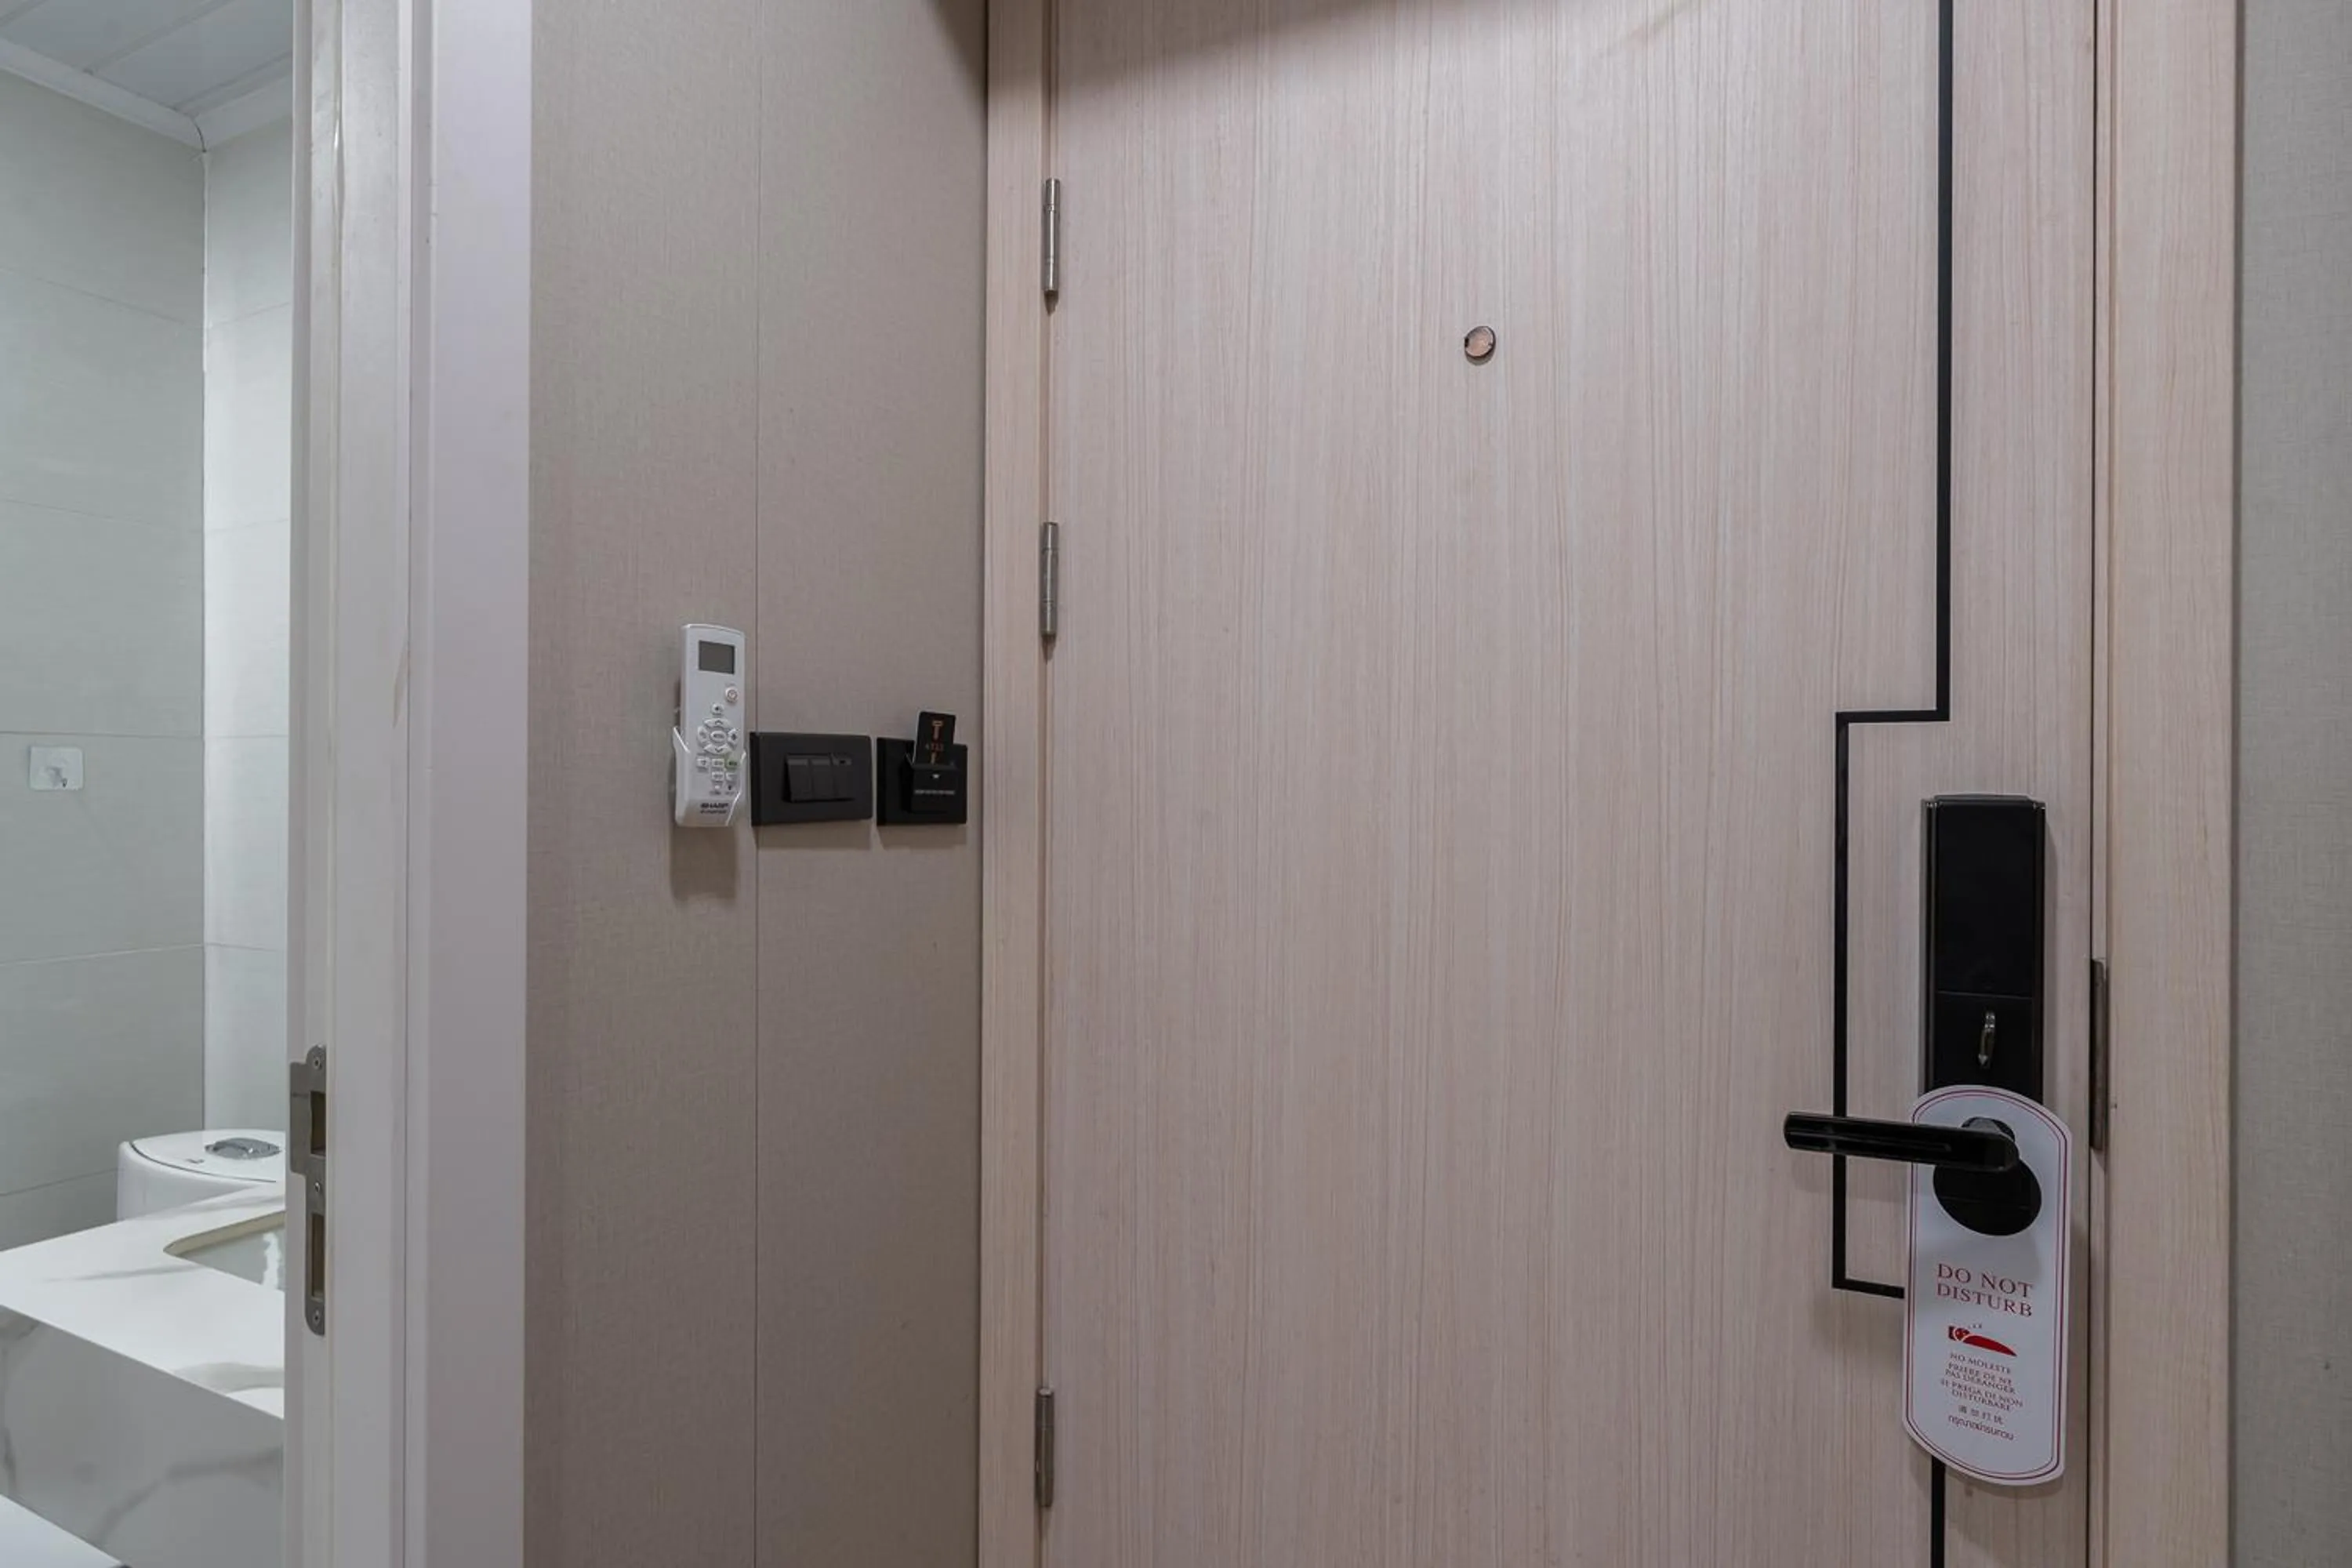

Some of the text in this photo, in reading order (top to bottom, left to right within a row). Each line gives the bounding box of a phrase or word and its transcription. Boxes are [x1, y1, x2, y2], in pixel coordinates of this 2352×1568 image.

[1937, 1263, 2033, 1298] DO NOT
[1937, 1283, 2033, 1317] DISTURB
[1950, 1352, 1965, 1362] NO
[1945, 1369, 1961, 1379] PAS
